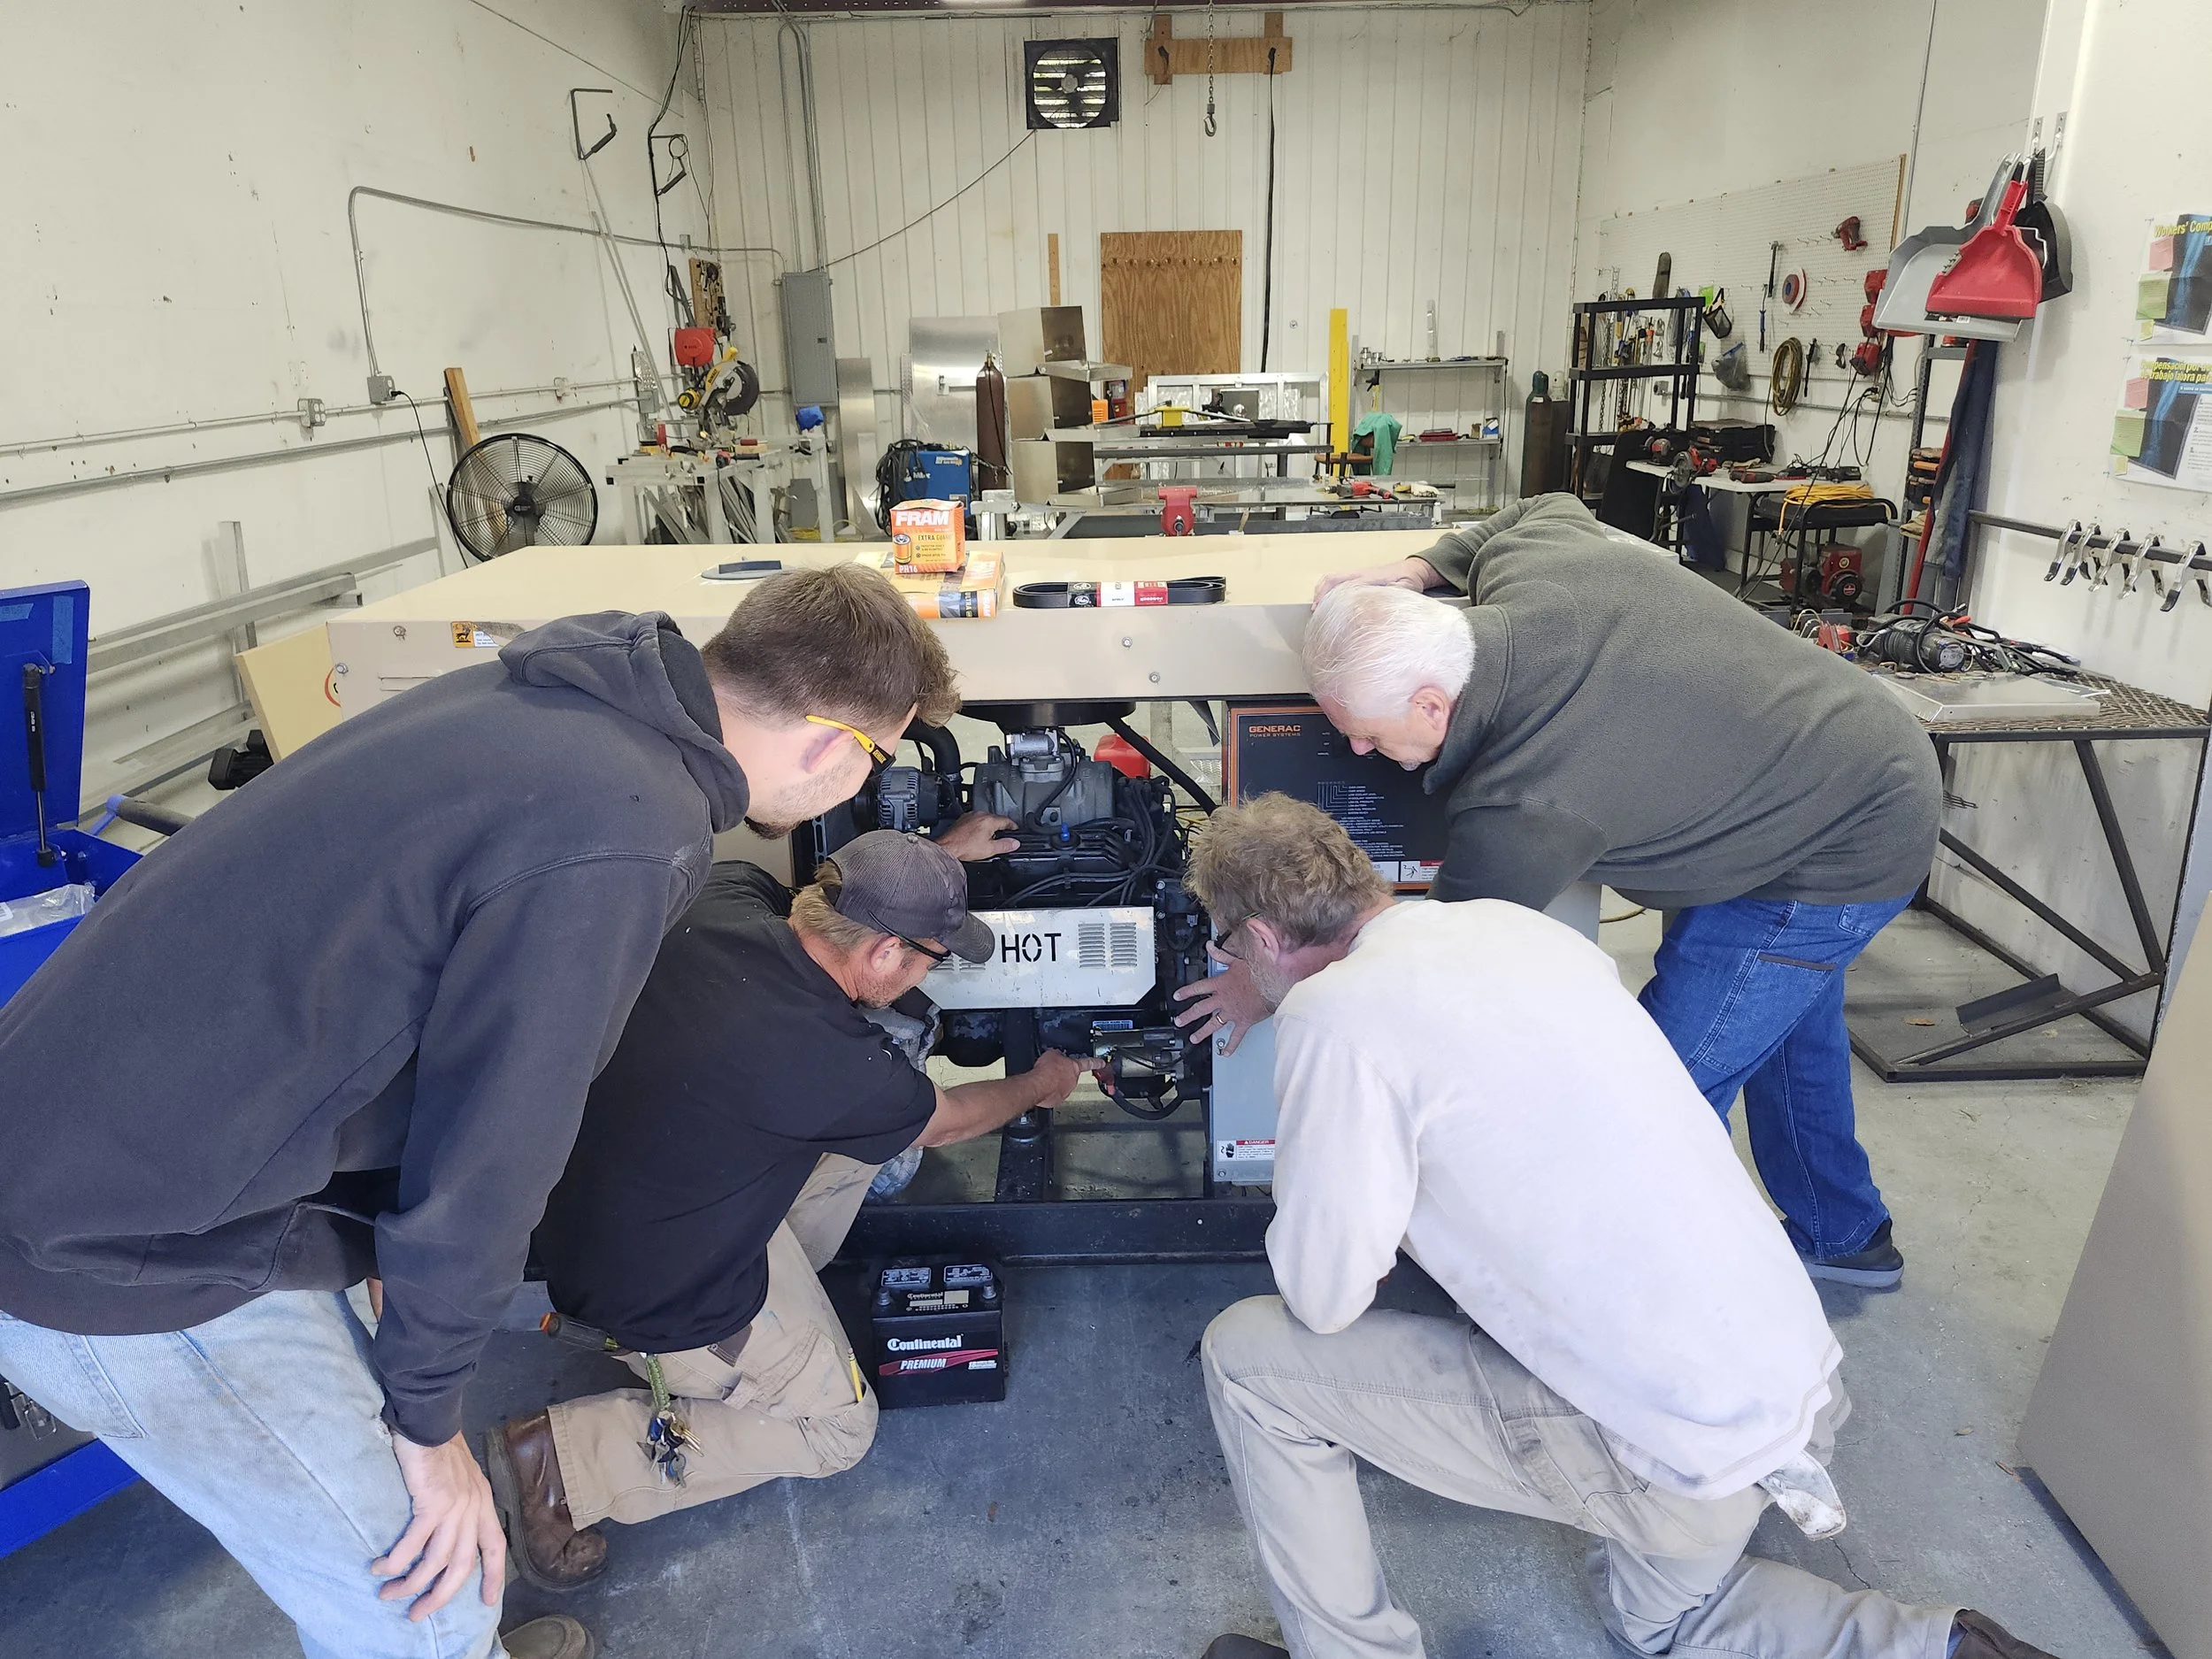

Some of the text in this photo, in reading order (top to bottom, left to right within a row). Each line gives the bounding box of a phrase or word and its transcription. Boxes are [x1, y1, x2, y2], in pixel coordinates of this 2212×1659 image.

[2154, 221, 2189, 237] Workers'
[895, 511, 949, 526] FRAM
[898, 565, 918, 573] PH16
[1248, 725, 1301, 733] GENERAC
[1001, 933, 1062, 964] HOT
[887, 1334, 963, 1351] Continental
[900, 1358, 948, 1371] PREMIUM
